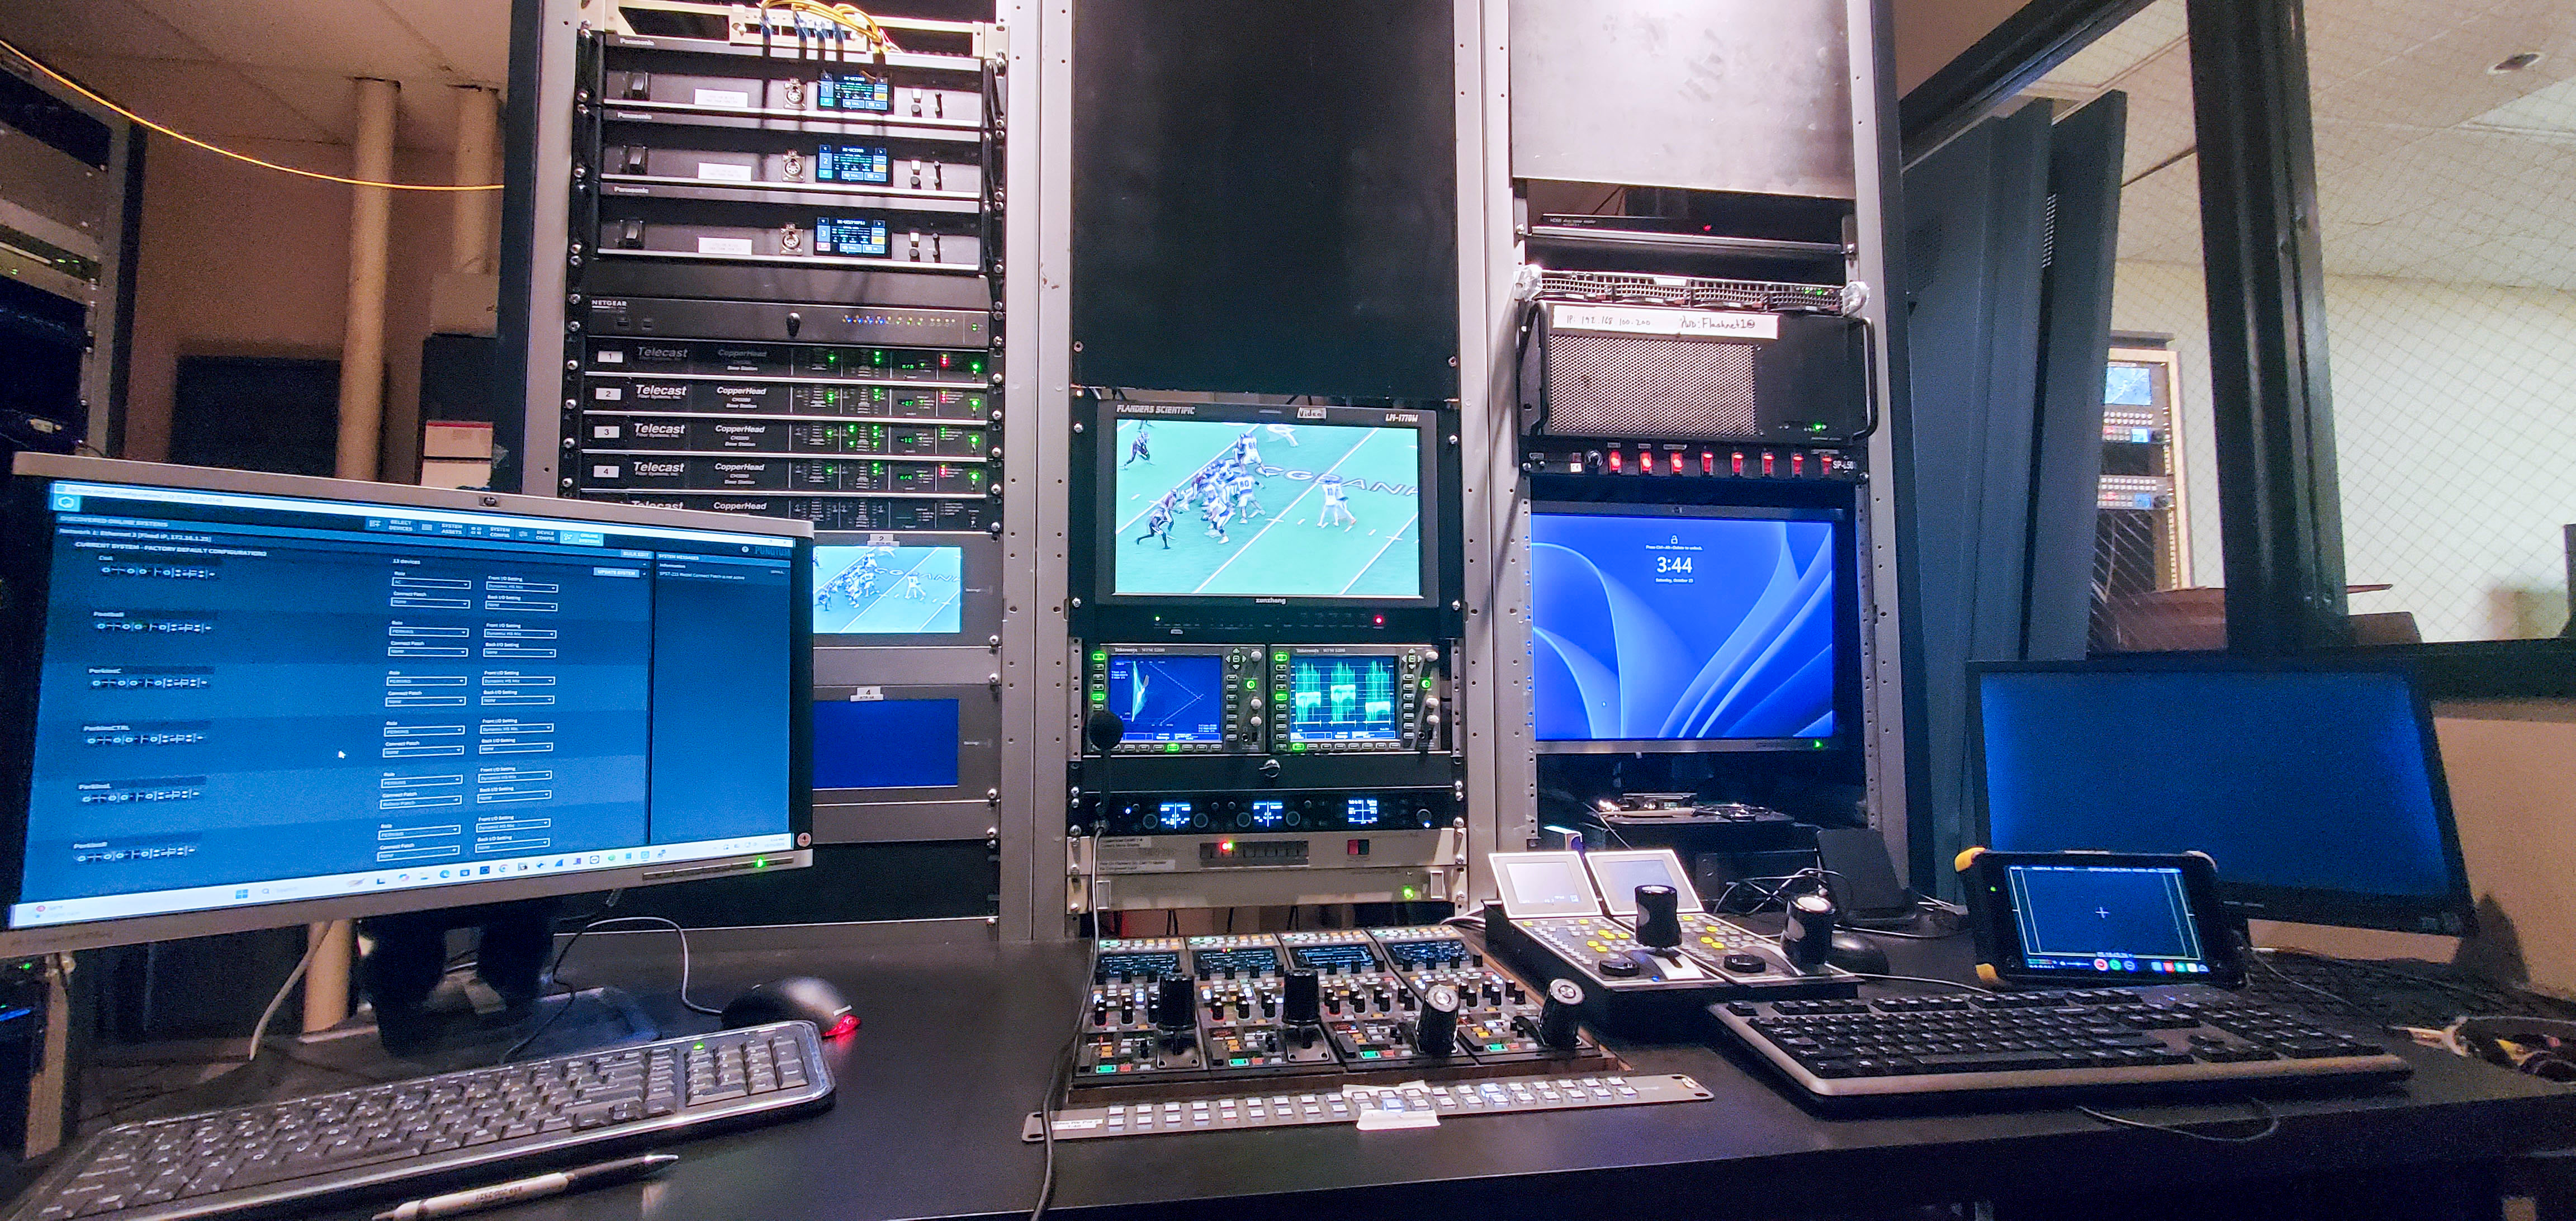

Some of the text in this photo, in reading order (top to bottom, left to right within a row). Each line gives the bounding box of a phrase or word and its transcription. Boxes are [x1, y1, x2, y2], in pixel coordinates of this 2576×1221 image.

[619, 37, 655, 46] Panasonic
[617, 111, 652, 120] Panasonic
[638, 347, 688, 358] Telecast
[718, 349, 768, 357] CopperHead
[636, 385, 687, 396] Telecast
[717, 386, 767, 395] CopperHead
[1116, 404, 1196, 415] FLANDERS SCIENTIFIC
[634, 423, 685, 434] Telecast
[715, 424, 765, 433] CopperHead
[633, 462, 685, 473] Telecast
[714, 463, 765, 472] CopperHead
[713, 501, 768, 511] CopperHead
[1657, 556, 1693, 573] 3:44
